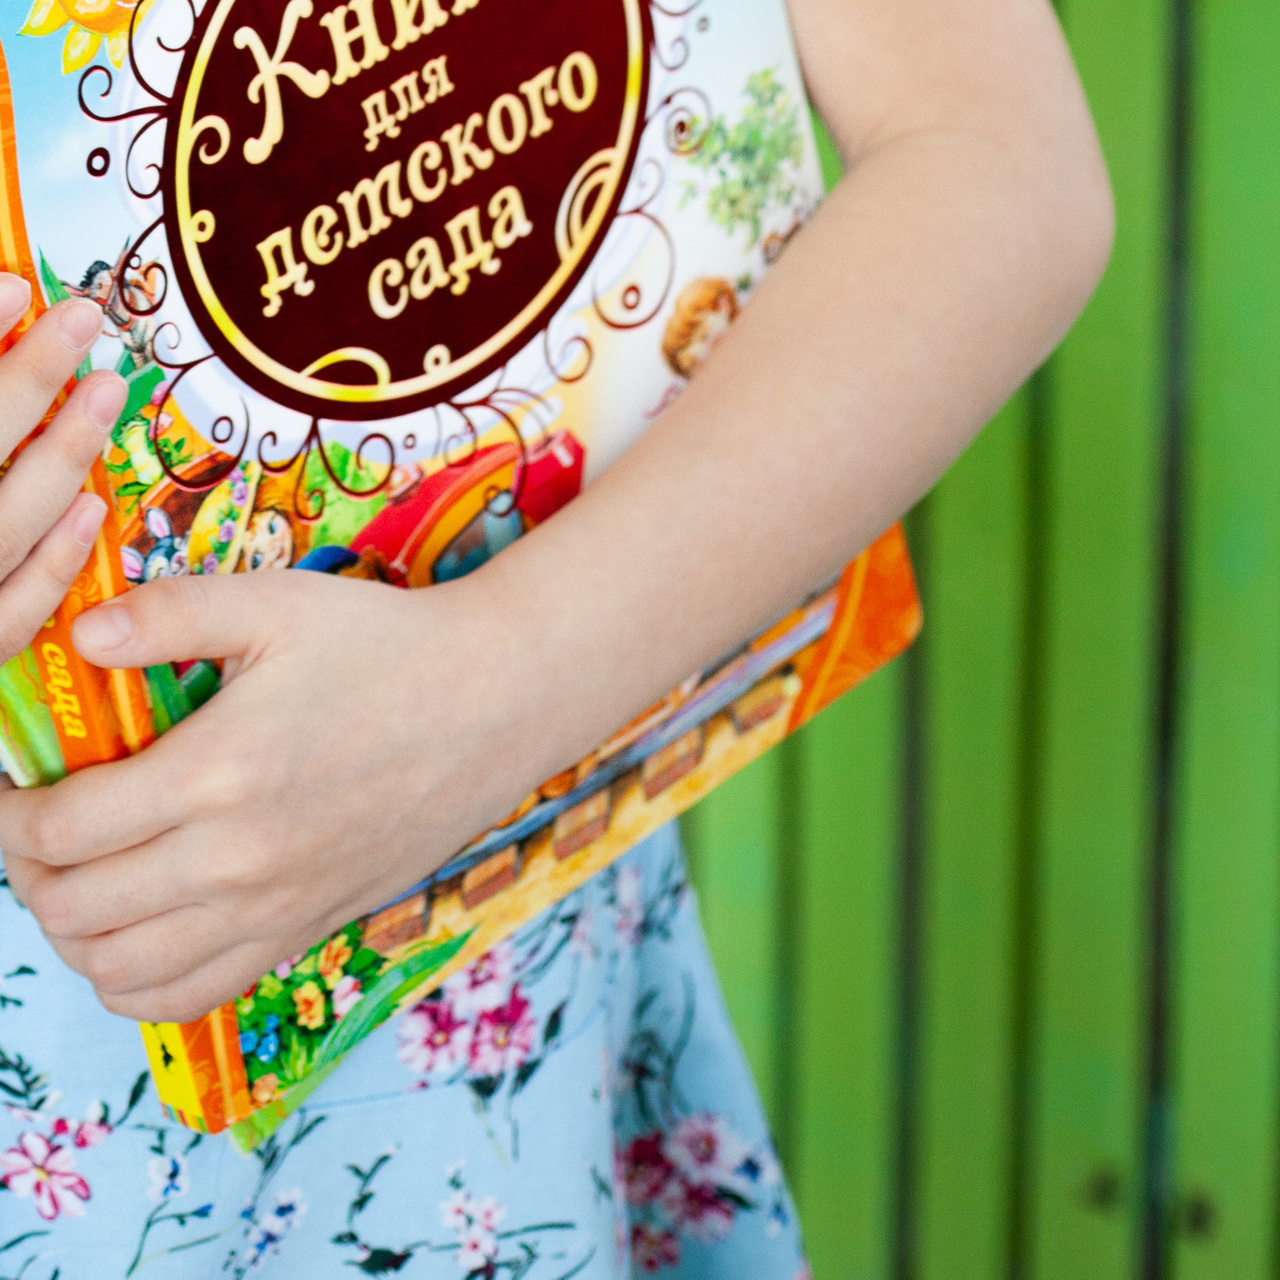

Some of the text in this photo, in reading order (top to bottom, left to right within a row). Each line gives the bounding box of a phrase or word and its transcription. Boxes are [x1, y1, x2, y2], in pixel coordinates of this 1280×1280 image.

[361, 55, 455, 152] для
[255, 51, 598, 318] детского
[367, 185, 533, 320] сада
[40, 641, 88, 740] сада
